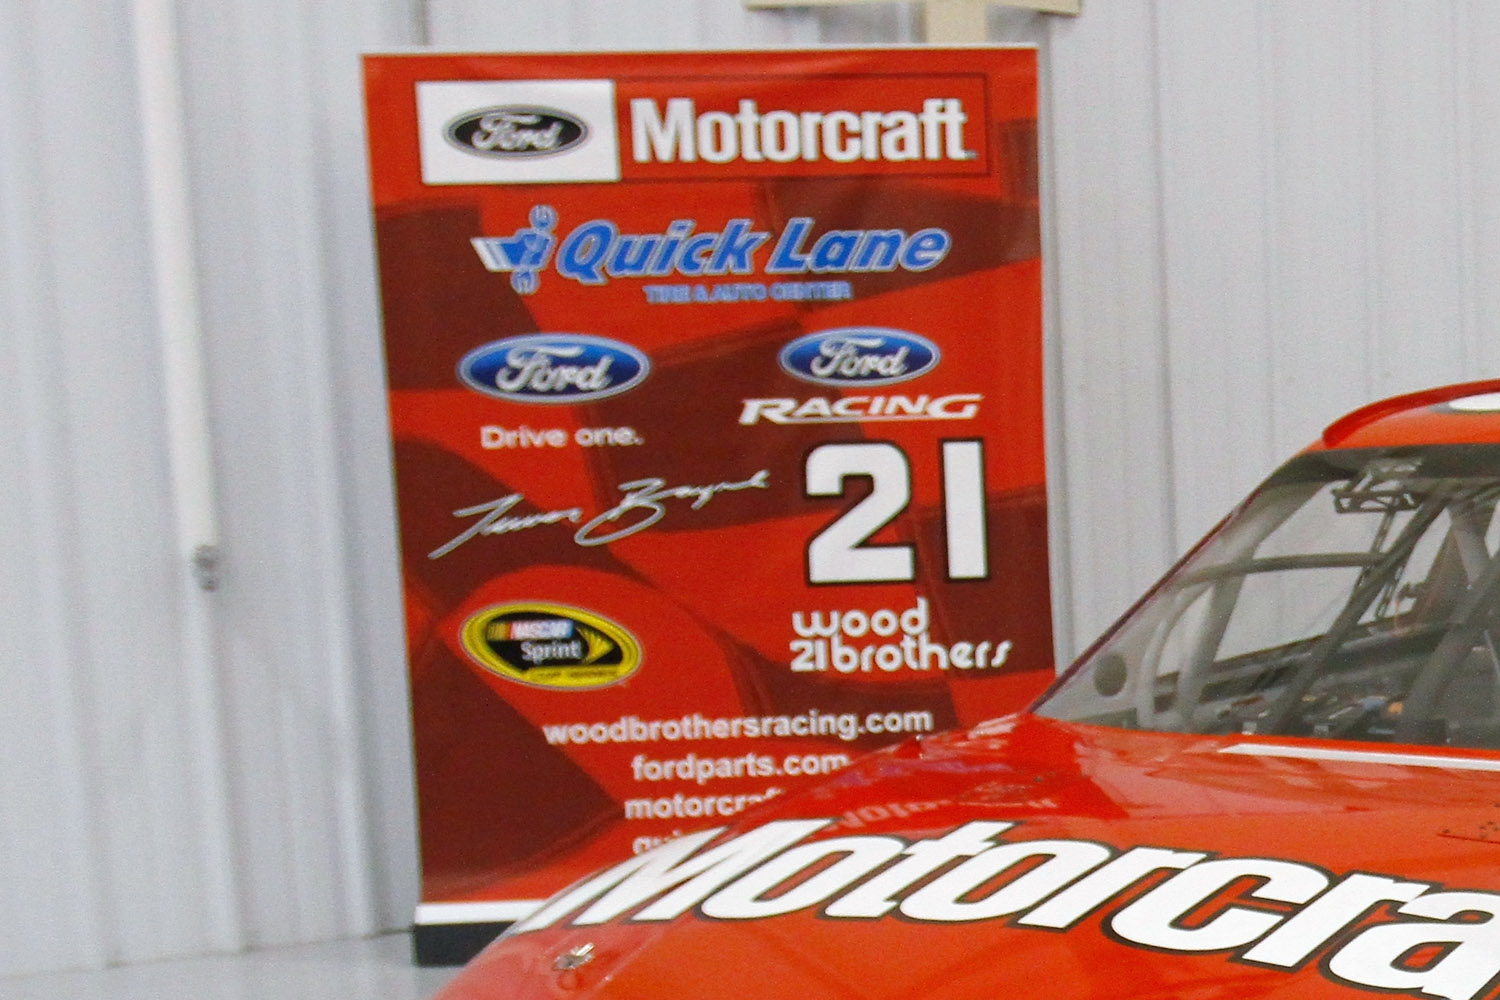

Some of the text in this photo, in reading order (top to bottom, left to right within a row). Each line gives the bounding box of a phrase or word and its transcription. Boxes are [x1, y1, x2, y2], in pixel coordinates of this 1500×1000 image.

[472, 98, 968, 163] Ford Motorcraft
[557, 218, 950, 285] Quick Lane
[495, 341, 611, 392] Ford
[810, 336, 907, 378] Ford
[740, 395, 983, 424] RACING
[481, 425, 644, 448] Drive one.
[804, 440, 990, 585] 21
[792, 598, 928, 635] wood
[520, 641, 582, 665] Sprint
[545, 710, 933, 745] woodbrothersracing.com
[632, 752, 850, 785] fordparts.com
